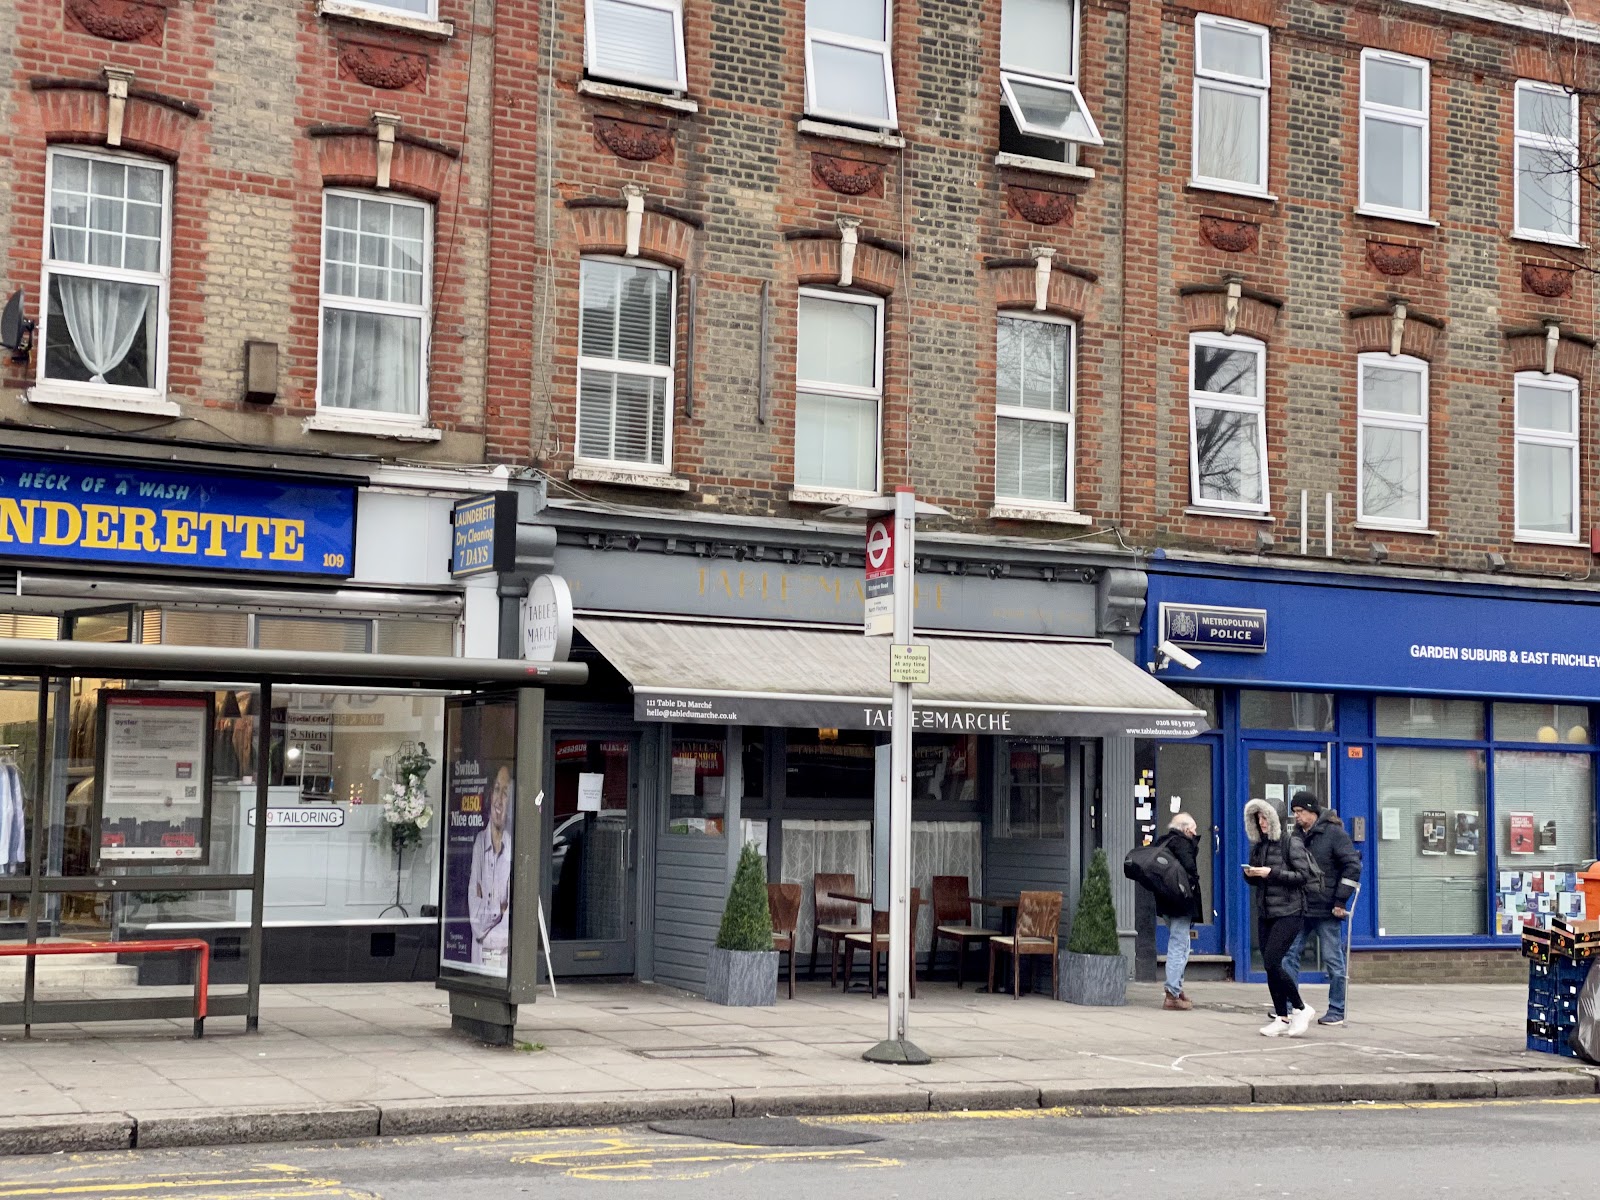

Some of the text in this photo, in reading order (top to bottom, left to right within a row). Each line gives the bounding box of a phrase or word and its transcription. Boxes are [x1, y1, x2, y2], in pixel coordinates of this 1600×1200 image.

[18, 472, 190, 500] HECK OF A WASH
[455, 503, 496, 528] LAUNDERETTE
[0, 497, 305, 562] NDERETTE
[456, 526, 493, 547] Dry Cleaning
[323, 553, 345, 568] 109
[460, 546, 489, 567] 7 DAYS
[529, 603, 551, 621] TABLE
[1202, 617, 1260, 629] METROPOLITAN
[1210, 628, 1252, 640] POLICE
[1411, 645, 1600, 668] GARDEN SUBURB & EAST FINCHLEY
[657, 699, 676, 708] Table
[677, 701, 686, 709] Du
[688, 701, 712, 710] Marché
[646, 709, 738, 721] hello@tabledumarche.co.uk
[936, 711, 1011, 731] MARCHÉ
[290, 729, 327, 739] 5 Shirts
[455, 760, 480, 776] Switch
[277, 811, 337, 823] TAILORING
[451, 811, 484, 827] Nice one.
